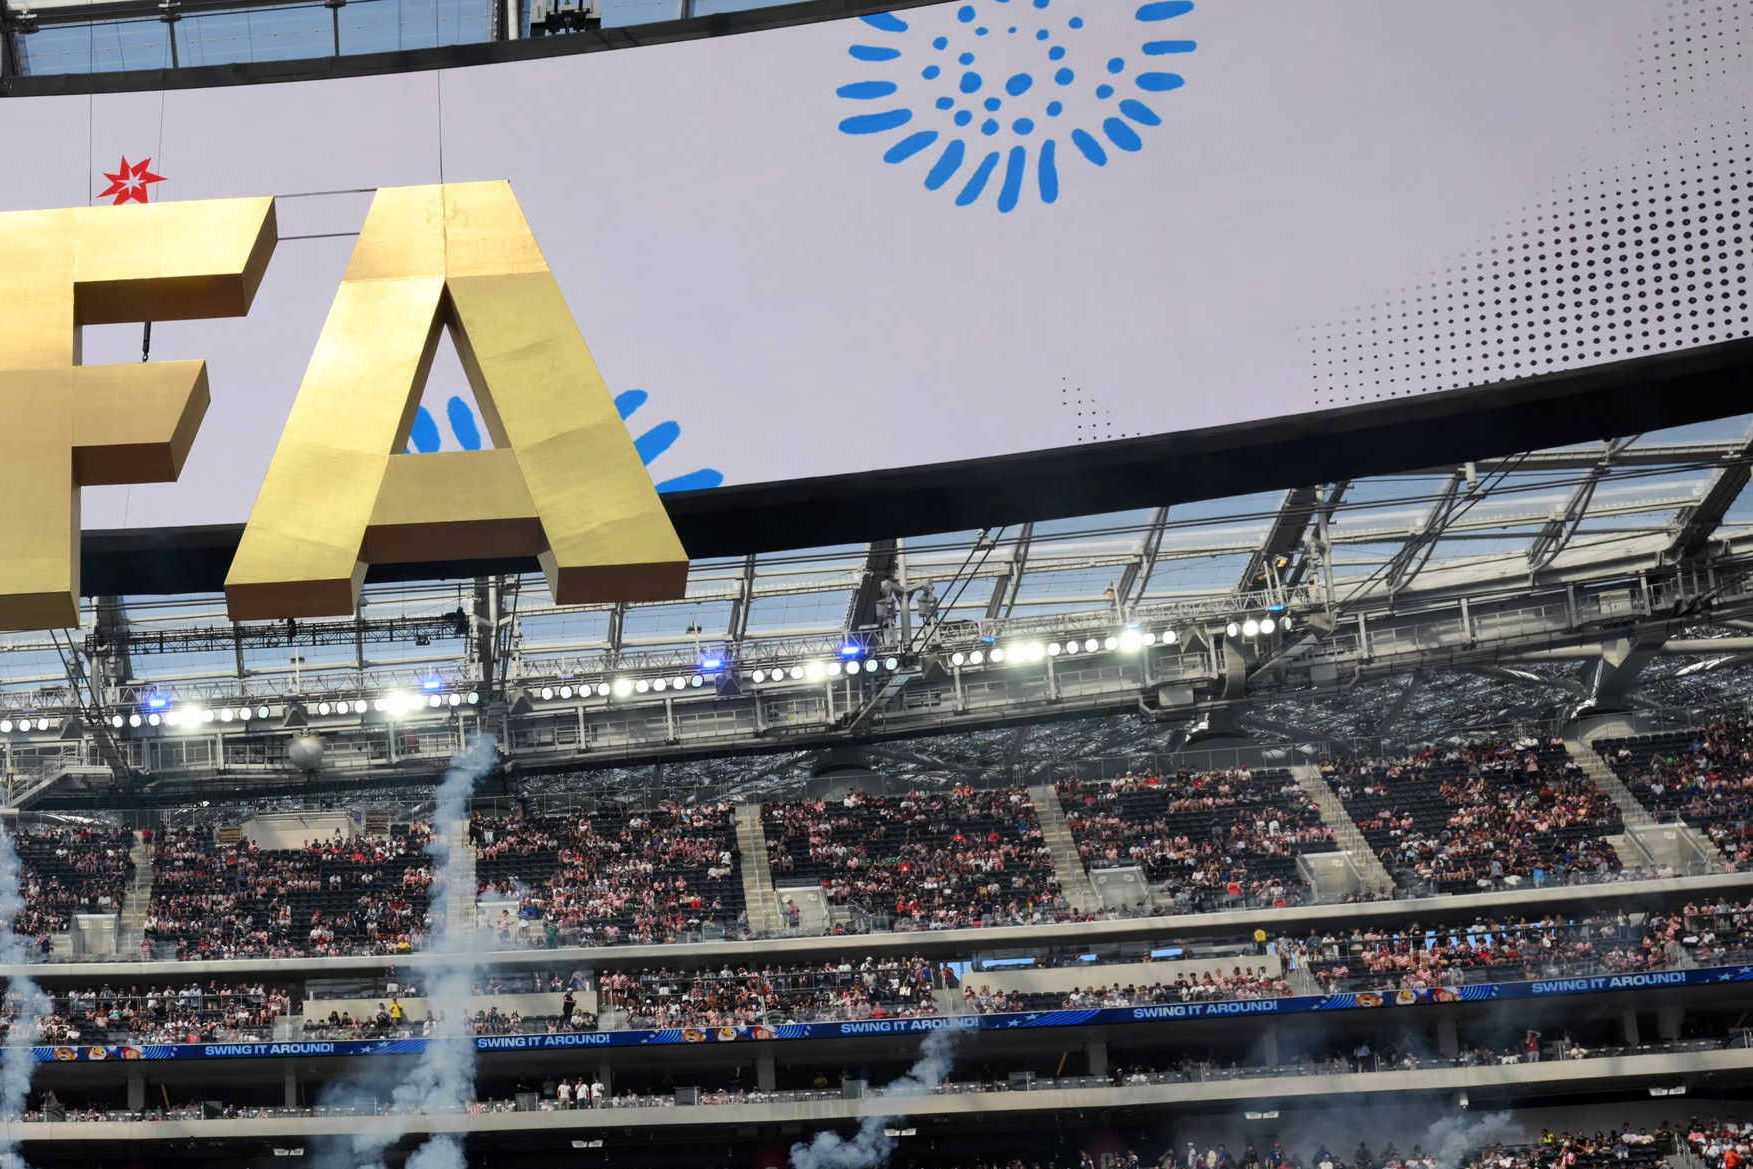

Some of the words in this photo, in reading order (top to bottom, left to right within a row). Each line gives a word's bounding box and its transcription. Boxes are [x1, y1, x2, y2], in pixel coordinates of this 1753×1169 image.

[1532, 980, 1586, 993] SWING
[1590, 978, 1605, 989] IT
[1609, 972, 1685, 987] AROUND!
[1133, 1006, 1185, 1018] SWING
[1189, 1005, 1203, 1015] IT
[1206, 1001, 1277, 1013] AROUND!
[841, 1021, 890, 1033] SWING
[893, 1020, 907, 1031] IT
[910, 1017, 979, 1030] AROUND!
[205, 1045, 251, 1055] SWING
[255, 1044, 267, 1054] IT
[270, 1043, 334, 1053] AROUND!
[477, 1037, 525, 1048] SWING
[529, 1036, 541, 1046] IT
[544, 1034, 609, 1045] AROUND!
